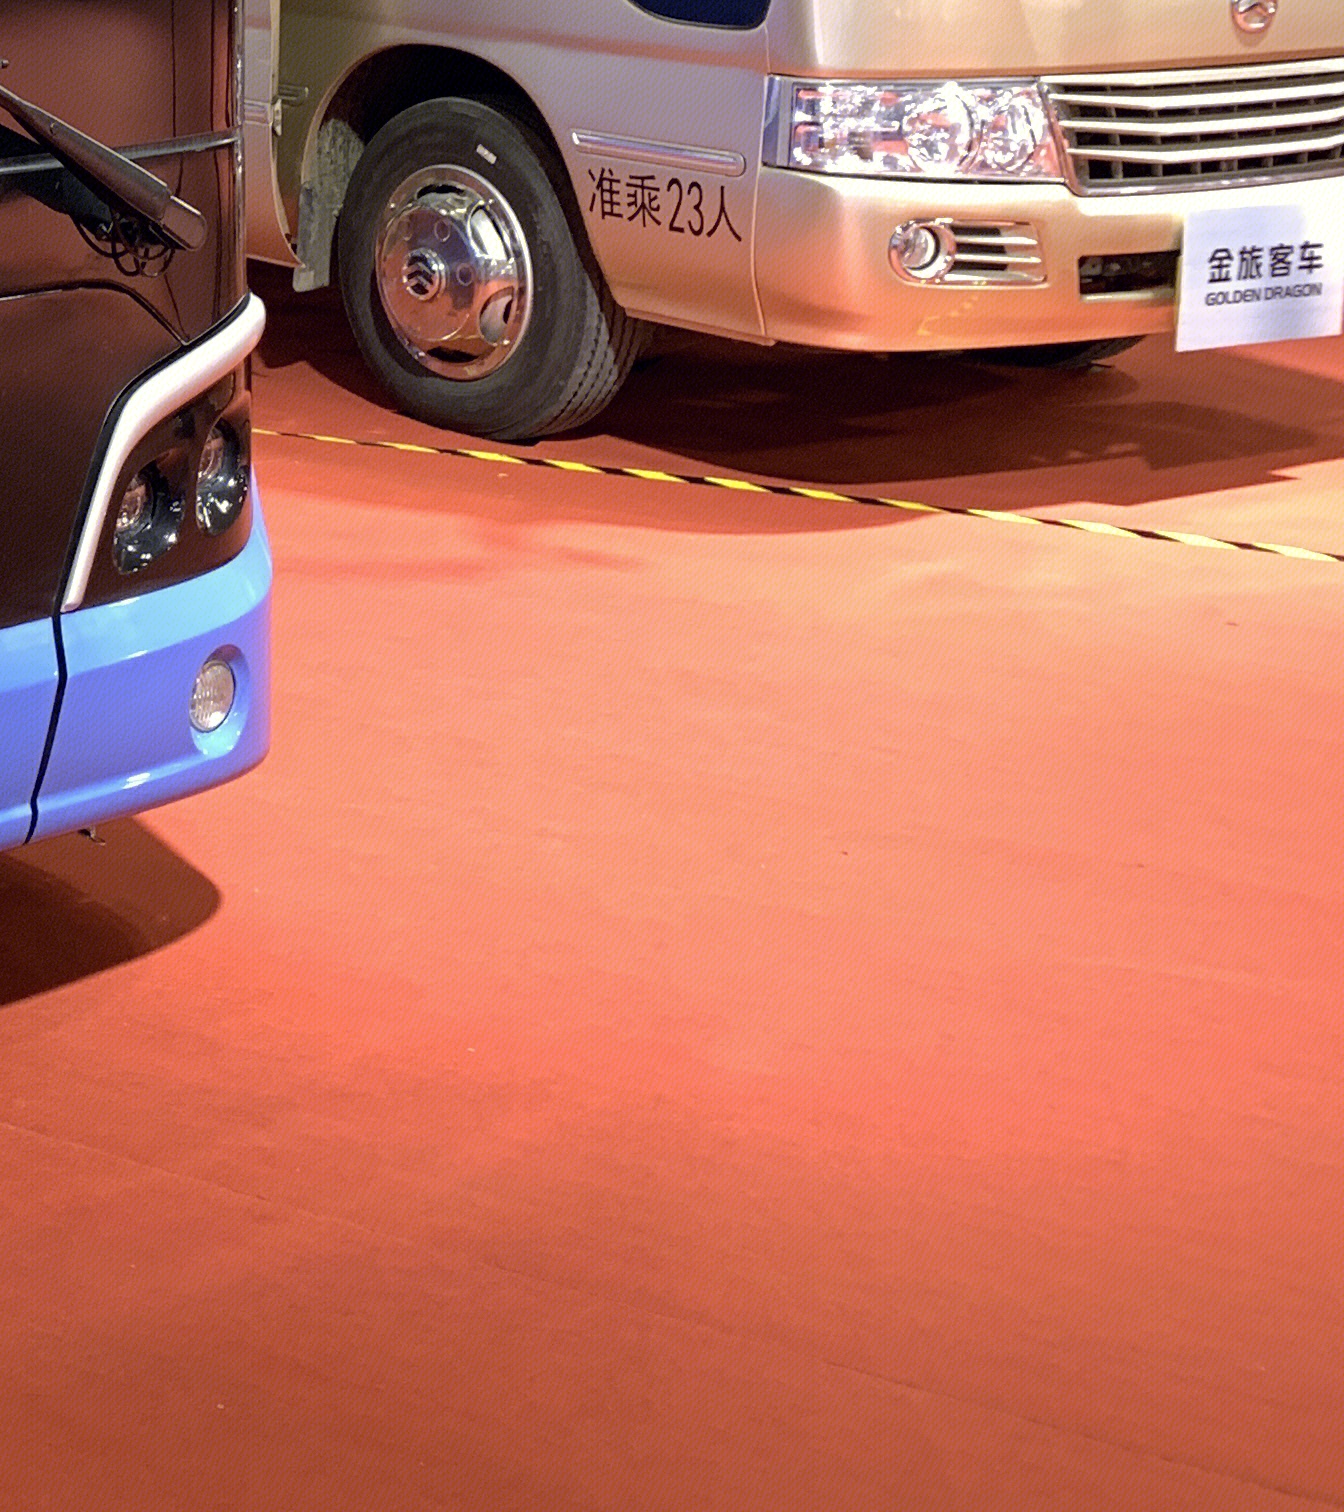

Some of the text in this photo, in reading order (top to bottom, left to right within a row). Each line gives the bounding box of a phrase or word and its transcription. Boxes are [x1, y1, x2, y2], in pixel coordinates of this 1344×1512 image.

[588, 167, 742, 242] 准乘23人
[1208, 240, 1324, 284] 金旅客车
[1205, 282, 1323, 306] GOLDEN DRAGON
